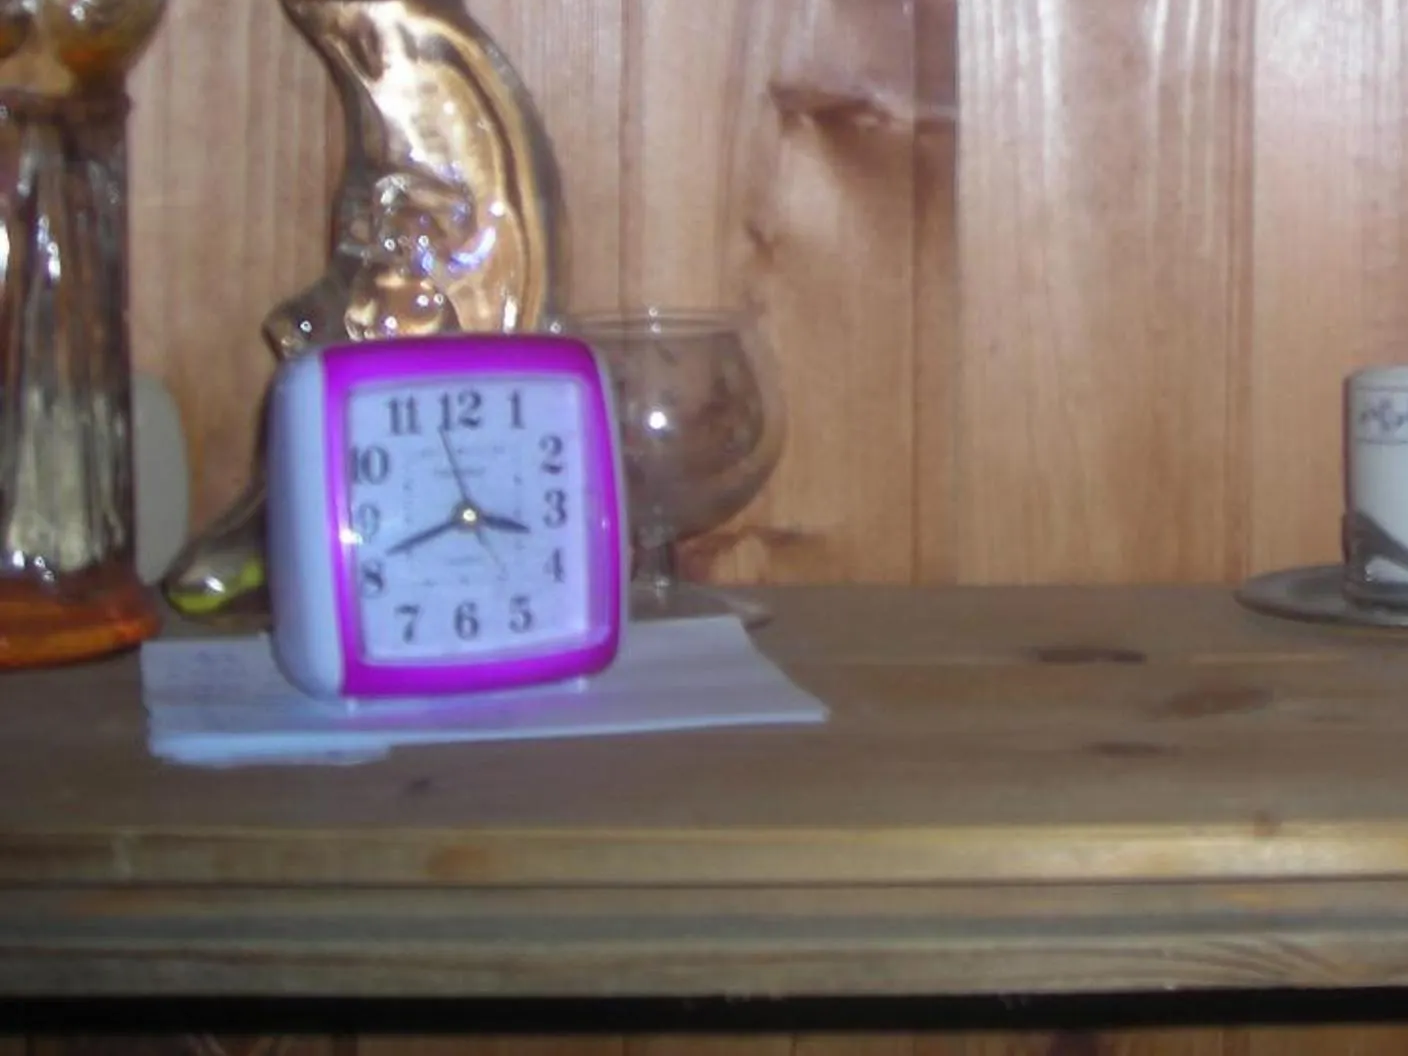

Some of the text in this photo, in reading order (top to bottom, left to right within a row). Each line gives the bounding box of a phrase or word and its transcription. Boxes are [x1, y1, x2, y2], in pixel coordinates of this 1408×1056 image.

[387, 396, 422, 436] 11
[438, 390, 483, 431] 12
[508, 390, 525, 430] 1
[352, 446, 390, 484] 10
[539, 435, 564, 475] 2
[358, 504, 381, 536] 9
[543, 489, 568, 528] 3
[361, 560, 386, 598] 8
[543, 548, 565, 583] 4
[395, 603, 422, 643] 7
[453, 601, 480, 640] 6
[508, 595, 534, 633] 5
